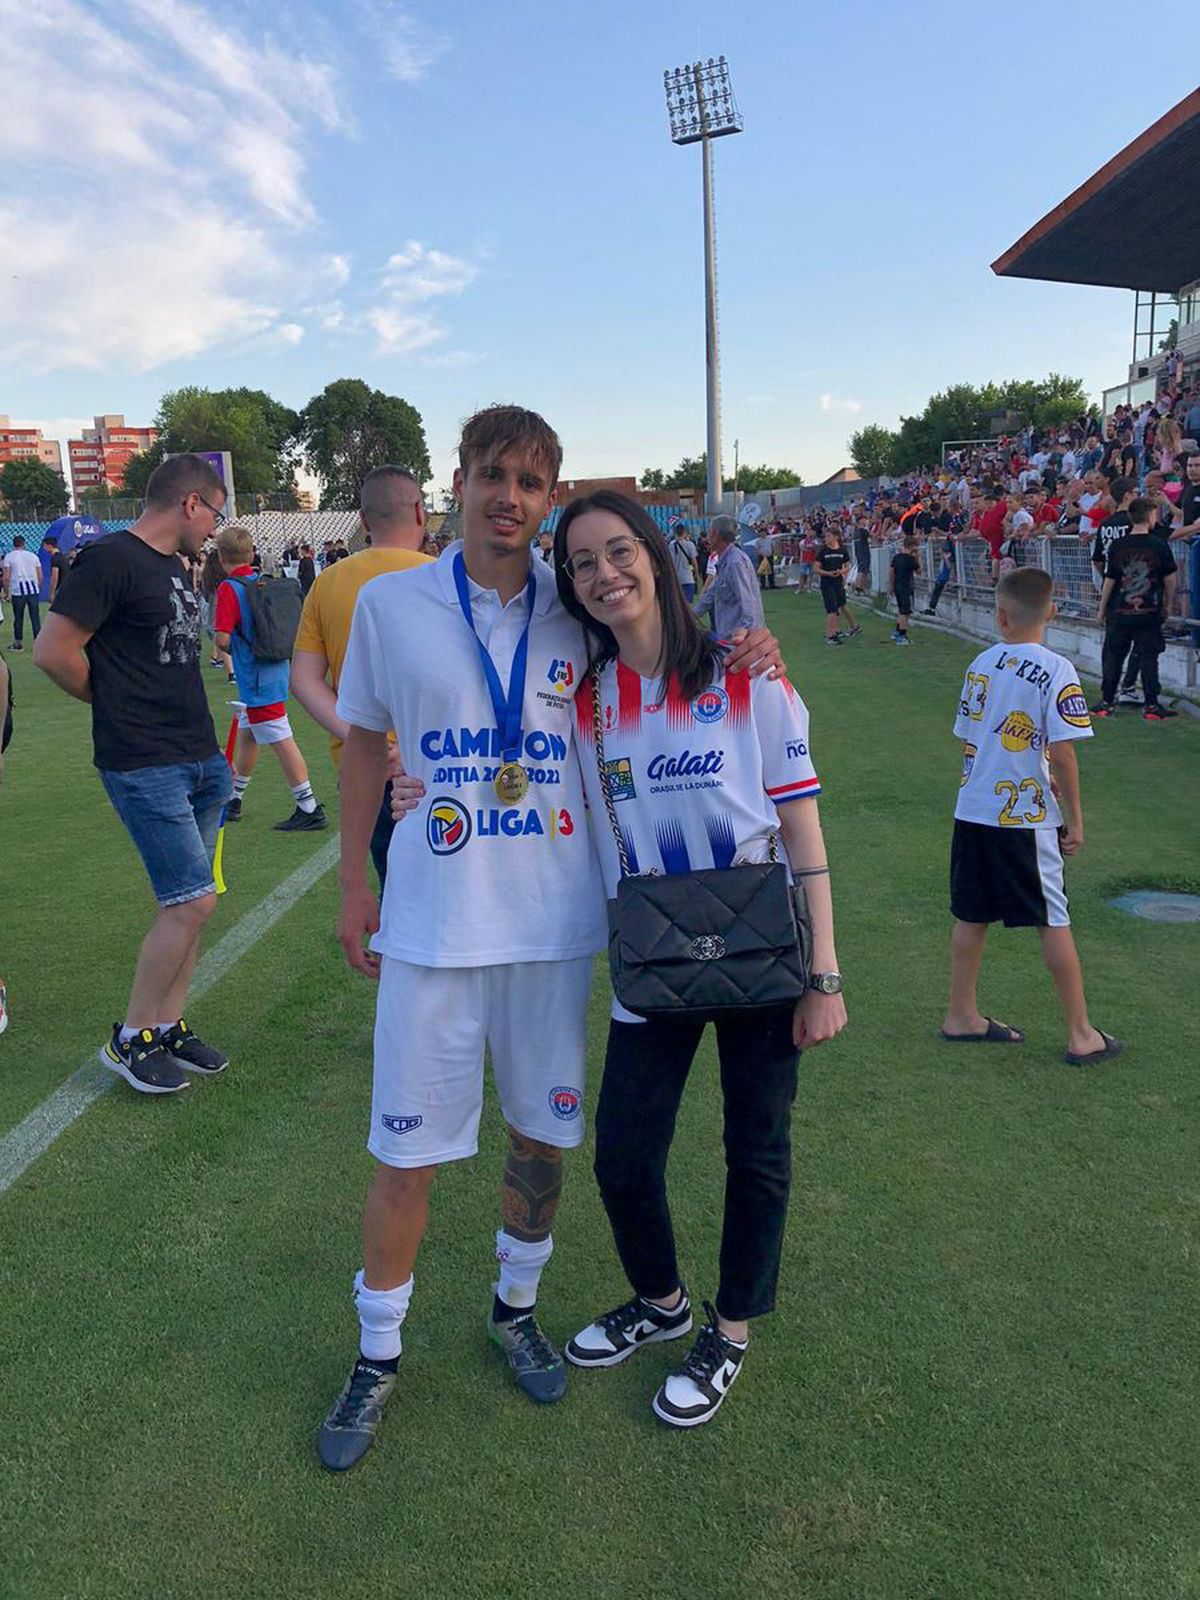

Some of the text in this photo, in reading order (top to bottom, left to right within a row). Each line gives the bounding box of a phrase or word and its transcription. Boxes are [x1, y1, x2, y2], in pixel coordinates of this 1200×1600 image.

[420, 727, 567, 761] CAMON
[992, 714, 1043, 751] LAKERS
[995, 777, 1047, 826] 23
[477, 808, 574, 837] LIGA 3
